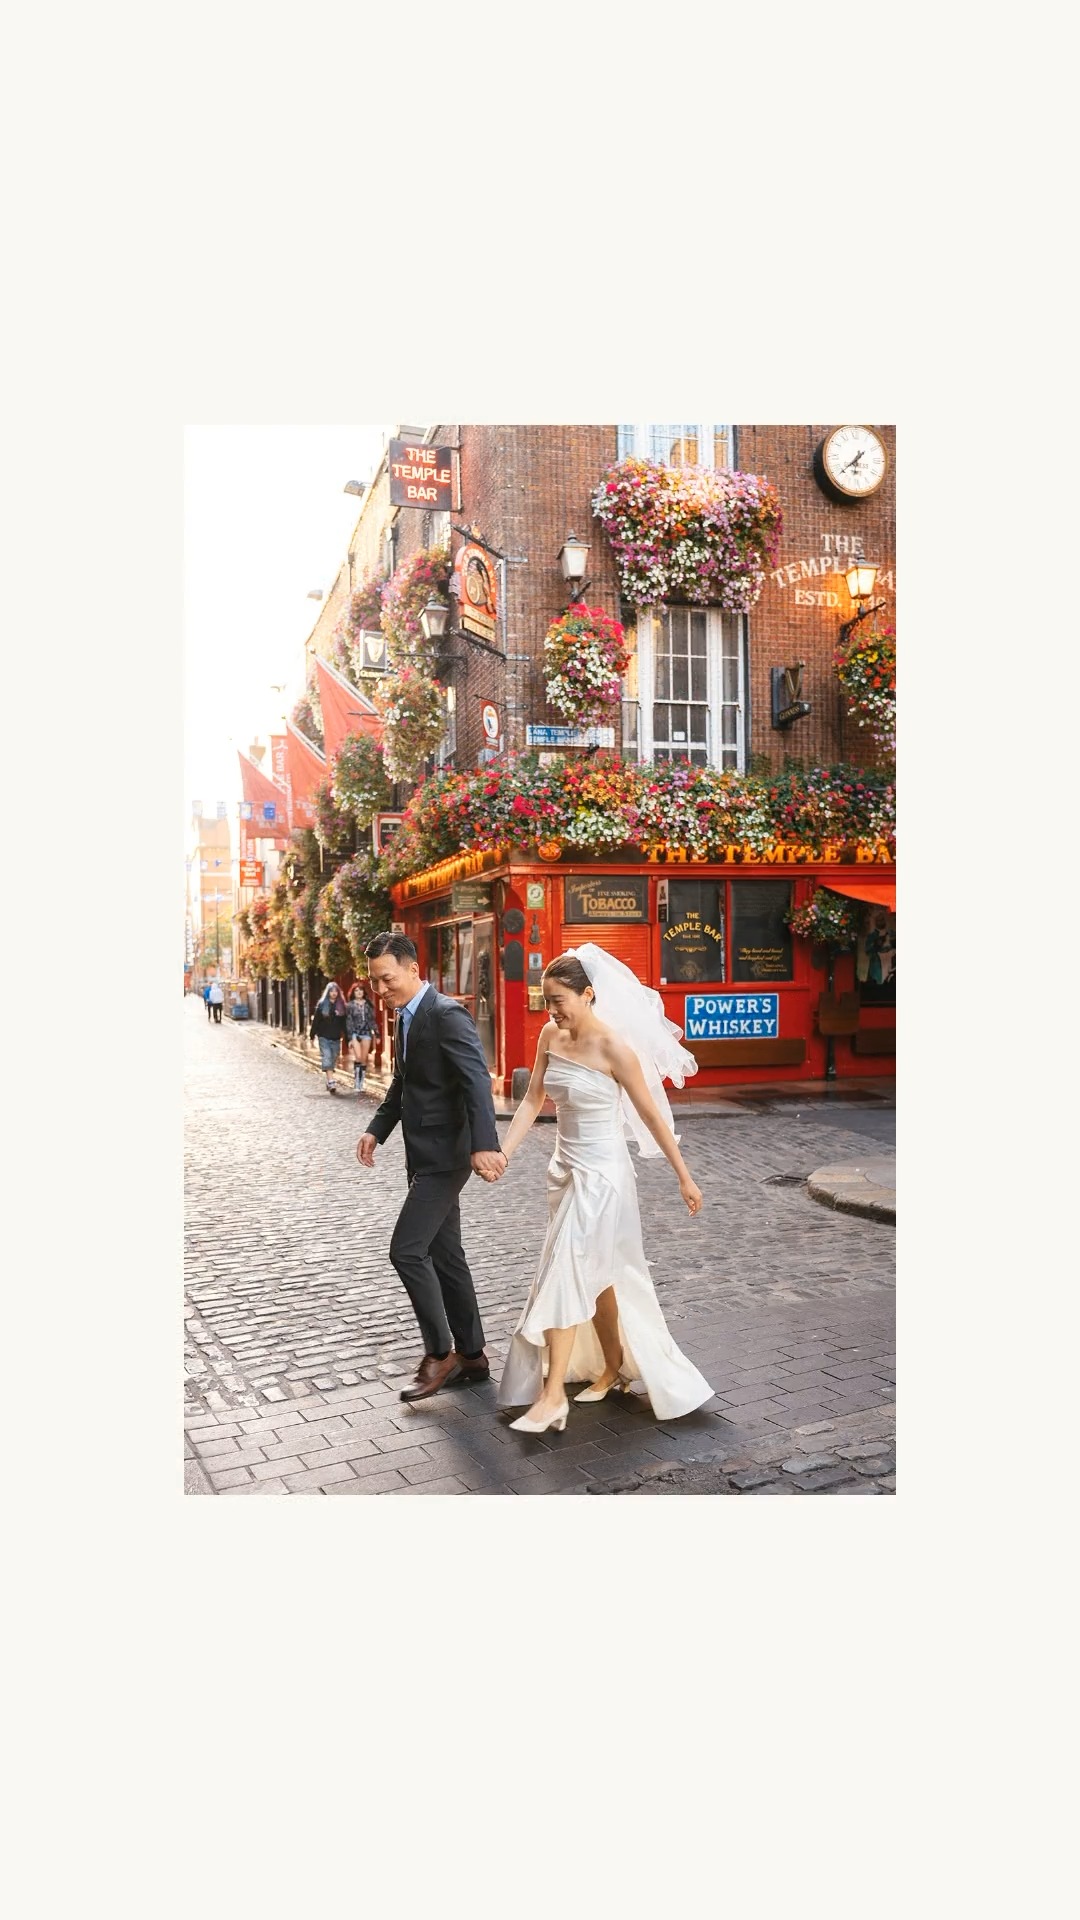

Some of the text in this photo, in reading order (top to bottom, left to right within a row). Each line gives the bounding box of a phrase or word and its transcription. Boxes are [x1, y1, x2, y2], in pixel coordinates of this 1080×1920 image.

[405, 447, 437, 464] THE
[391, 464, 451, 483] TEMPLE
[407, 485, 438, 501] BAR
[821, 534, 864, 555] THE
[794, 589, 843, 608] ESTD.
[642, 843, 709, 864] THE
[722, 843, 842, 864] TEMPLE
[579, 893, 637, 915] TOBACCO
[686, 912, 700, 920] THE
[663, 922, 722, 943] TEMPLE BAR
[693, 997, 772, 1015] POWER'S
[688, 1018, 776, 1036] WHISKEY
